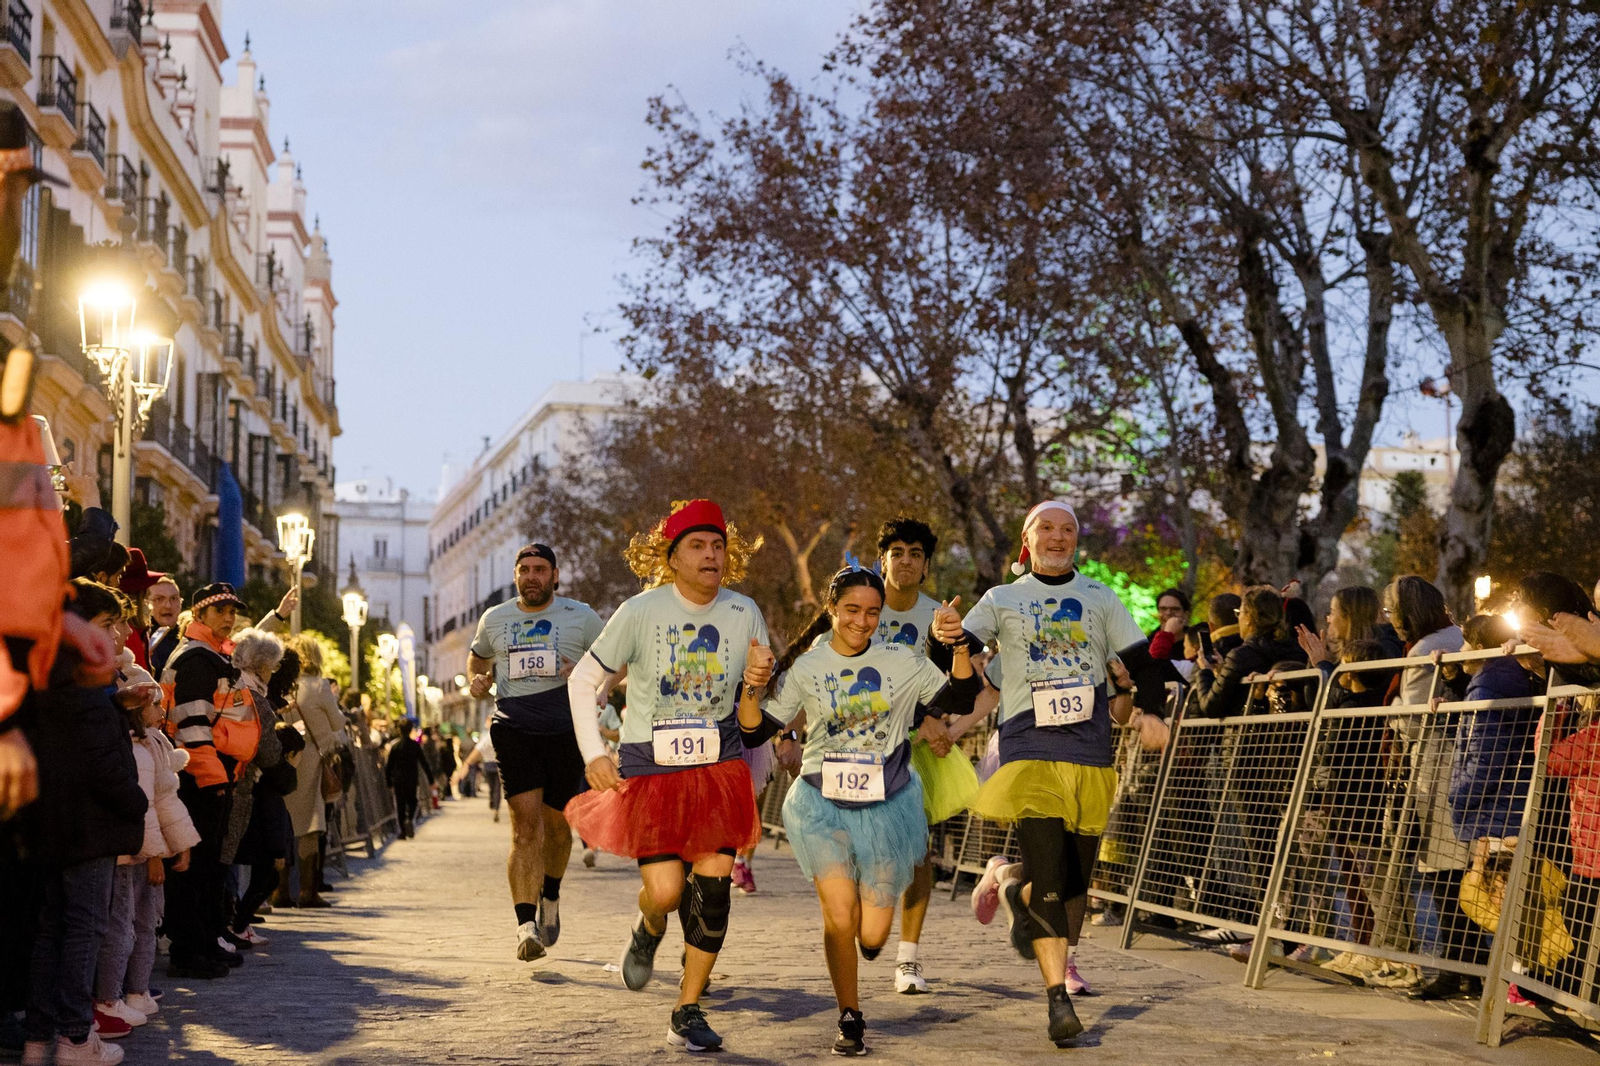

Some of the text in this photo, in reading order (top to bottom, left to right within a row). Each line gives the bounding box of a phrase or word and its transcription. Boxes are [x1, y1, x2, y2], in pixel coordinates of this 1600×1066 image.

[519, 656, 544, 670] 158
[1048, 695, 1083, 714] 193
[670, 736, 704, 755] 191
[835, 771, 869, 790] 192
